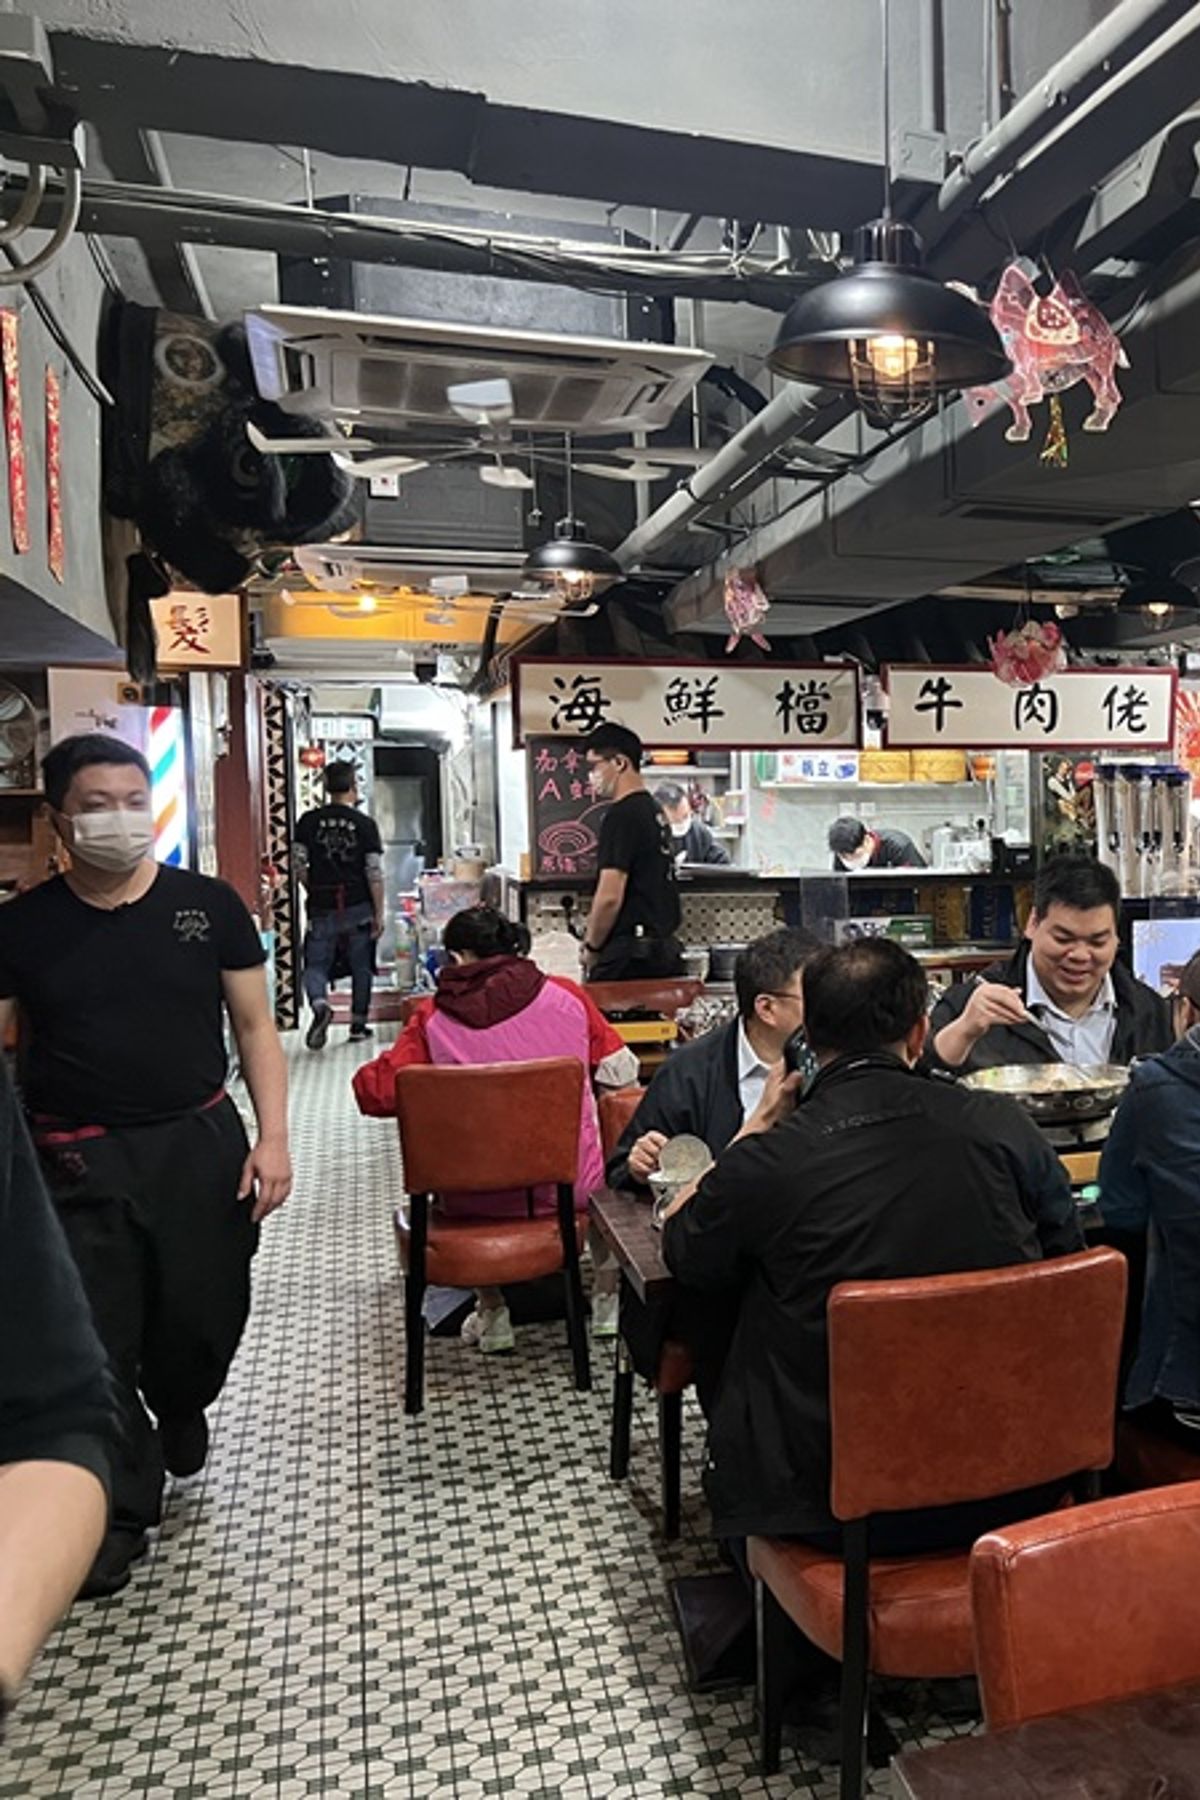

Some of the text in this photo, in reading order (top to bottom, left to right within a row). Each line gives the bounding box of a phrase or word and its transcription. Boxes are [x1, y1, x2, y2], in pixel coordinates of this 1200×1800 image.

[167, 605, 211, 654] 髮
[549, 674, 831, 734] 海鮮檔
[914, 677, 1149, 734] 牛肉佬
